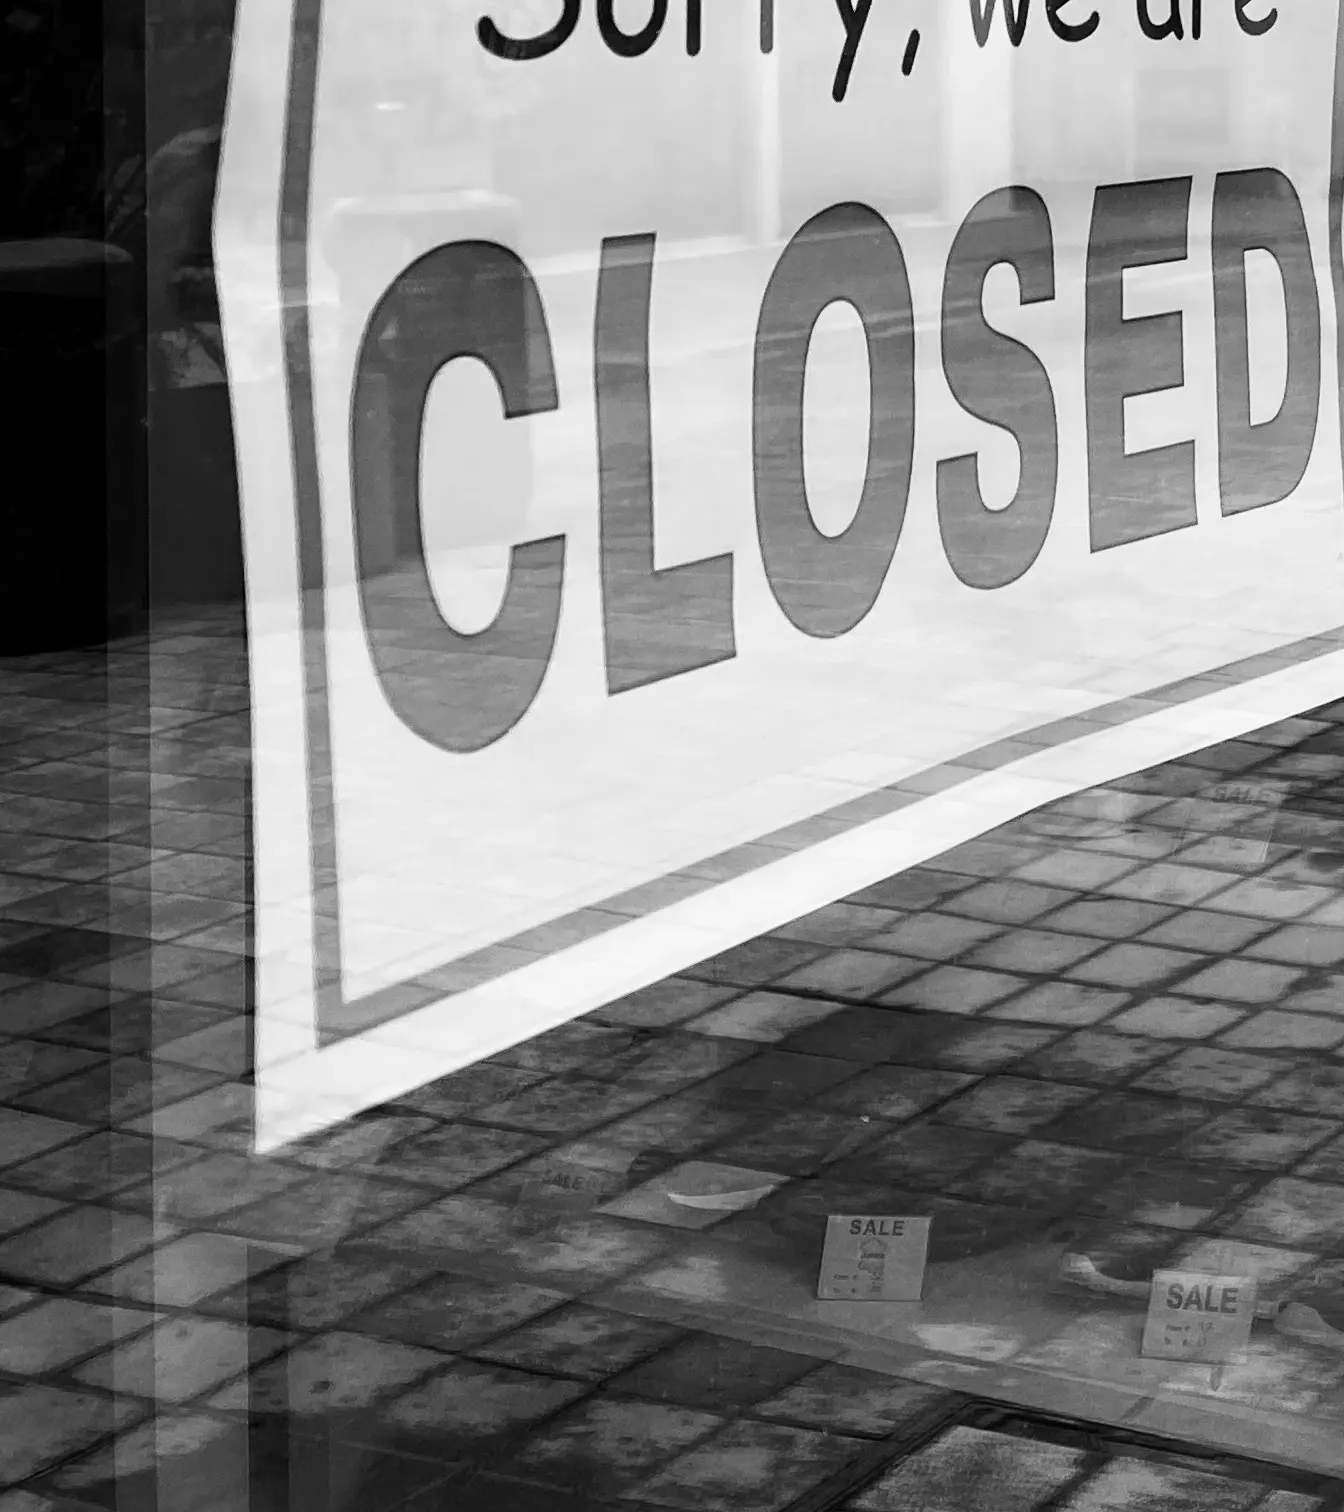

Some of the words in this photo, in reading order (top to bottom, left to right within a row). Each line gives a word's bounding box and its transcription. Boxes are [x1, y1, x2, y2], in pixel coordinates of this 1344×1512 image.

[351, 166, 1320, 755] CLOSED
[848, 1217, 906, 1238] SALE
[1165, 1282, 1239, 1315] SALE
